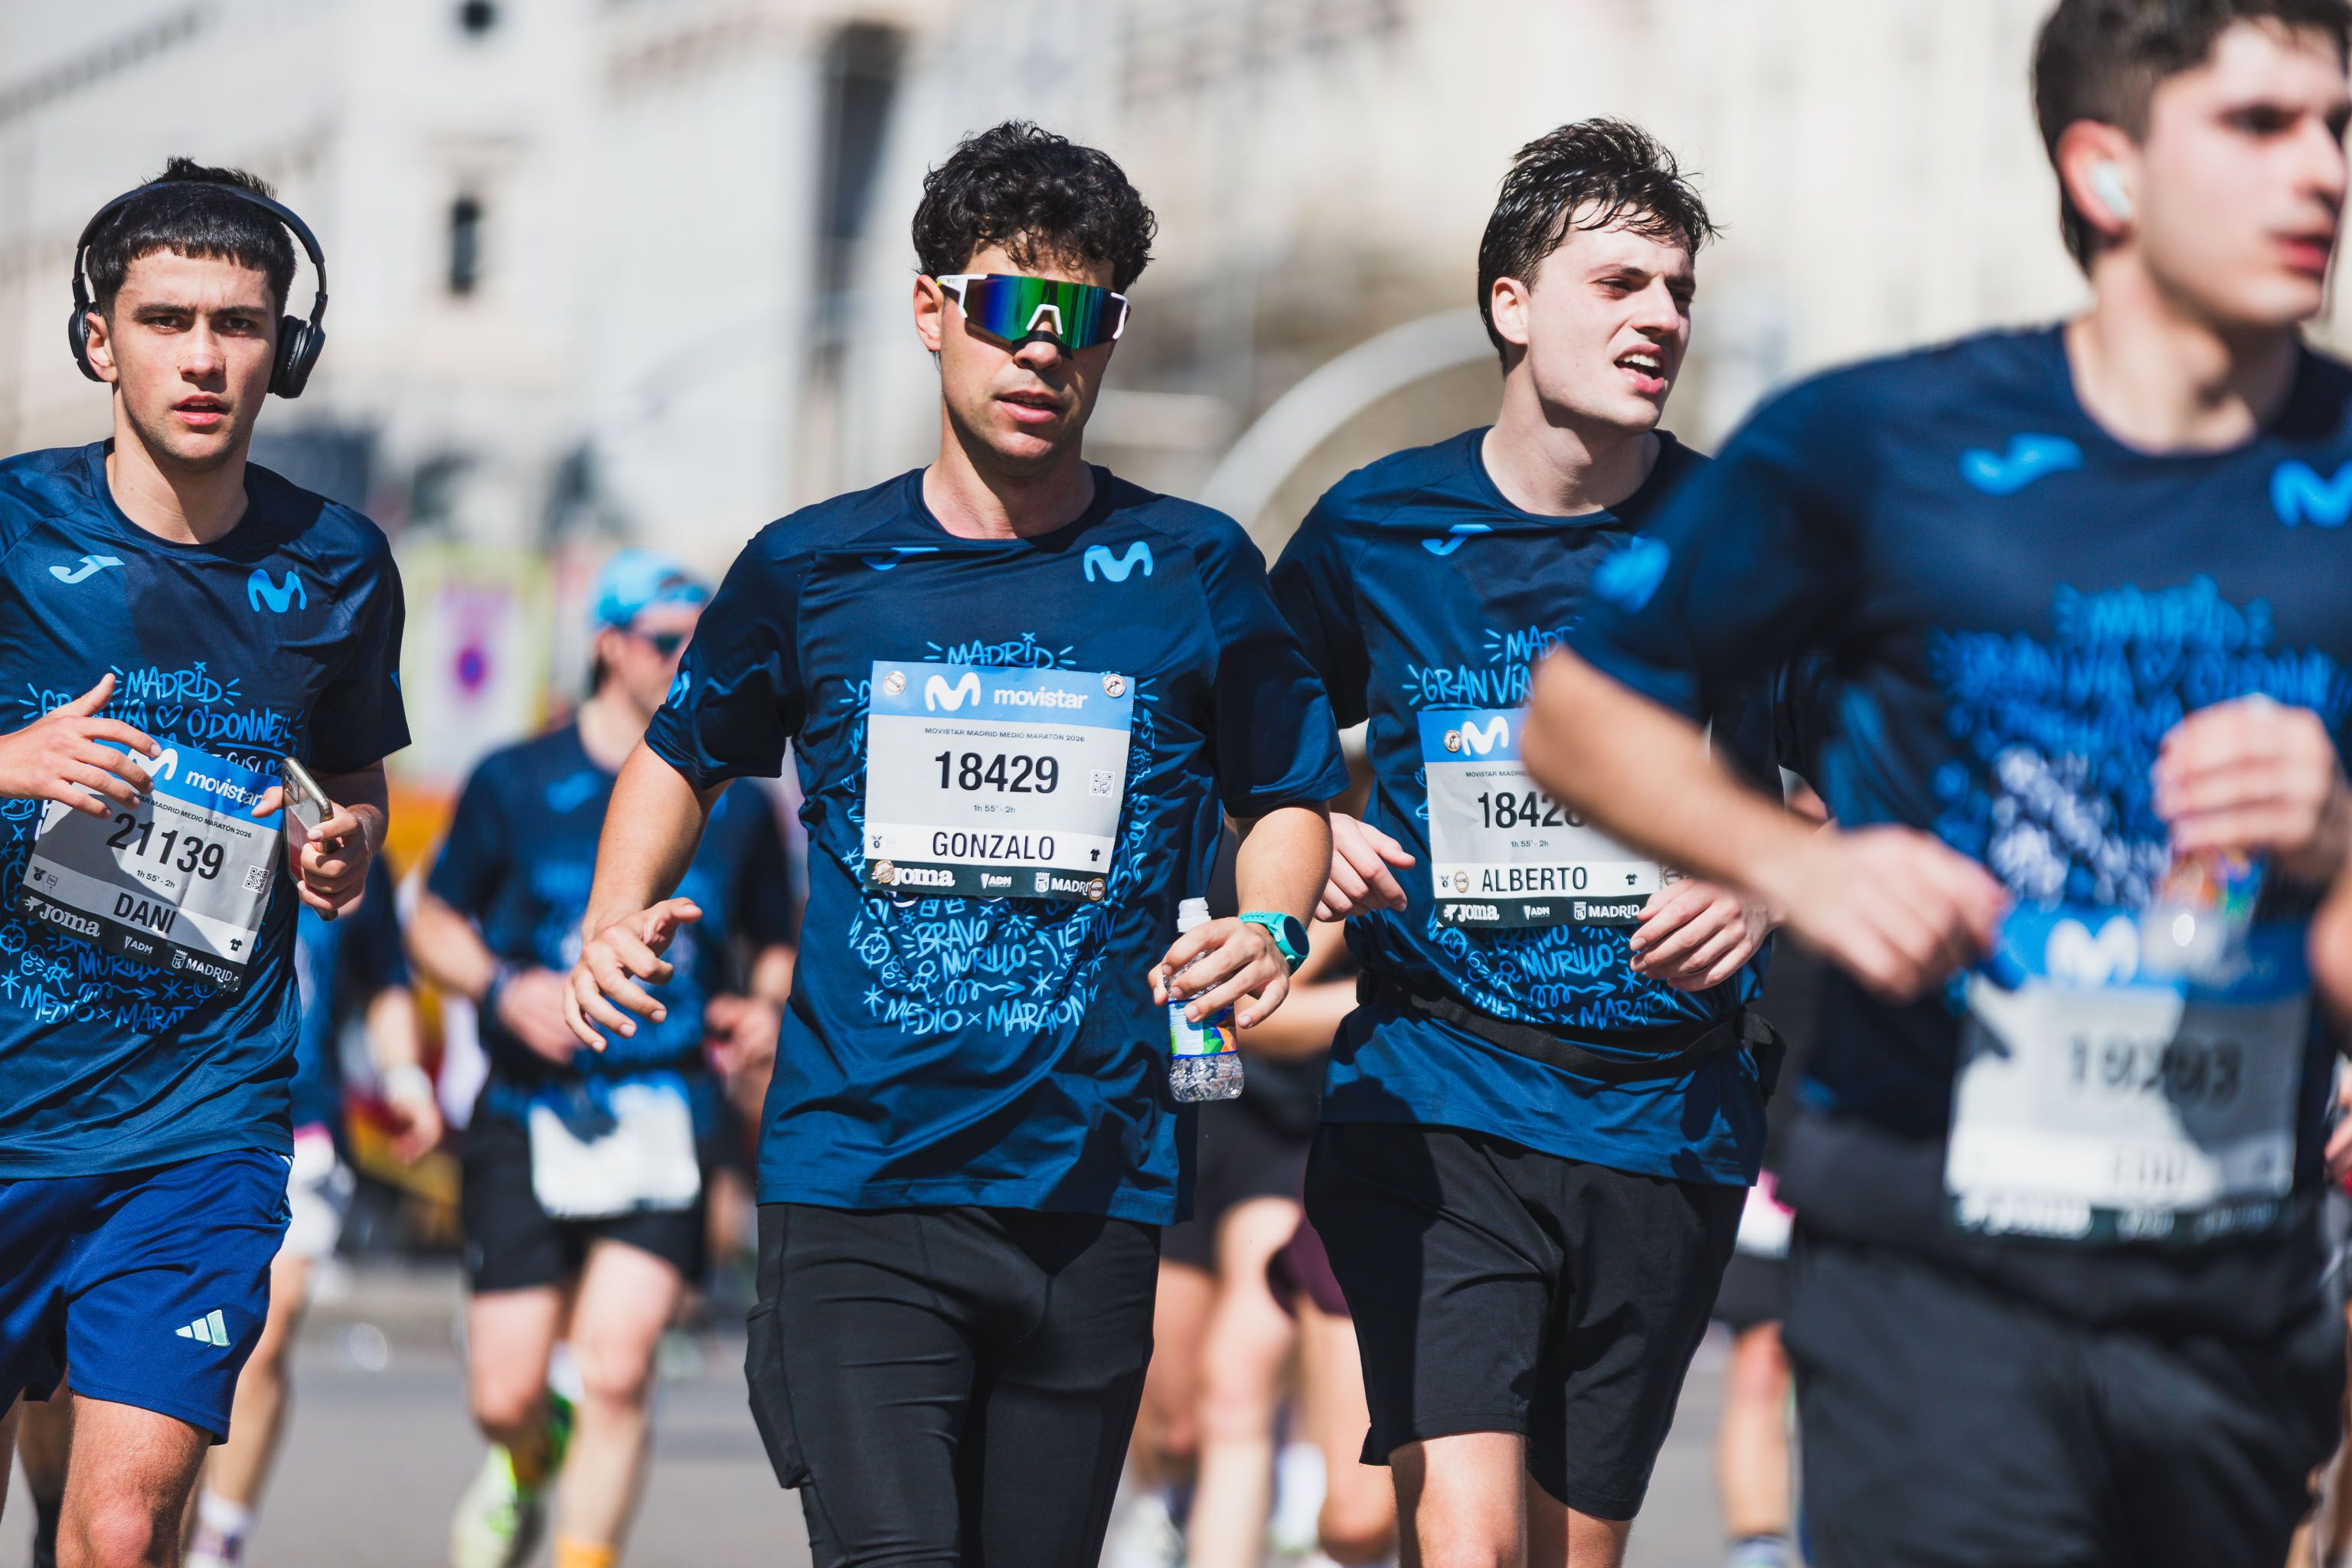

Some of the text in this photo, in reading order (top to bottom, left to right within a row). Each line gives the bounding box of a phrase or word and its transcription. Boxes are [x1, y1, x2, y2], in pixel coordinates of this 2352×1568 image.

[947, 632, 1054, 670] MADRID
[126, 662, 222, 704] MADRID
[993, 686, 1089, 710] movistar
[1422, 664, 1488, 704] GRAN
[925, 727, 965, 736] MOVISTAR
[966, 729, 998, 737] MADRID
[185, 770, 264, 807] movistar
[935, 750, 1060, 794] 18429
[152, 800, 179, 815] MADRID
[180, 809, 203, 823] MEDIO
[235, 828, 252, 838] 2026
[106, 812, 225, 880] 21139
[932, 831, 1055, 861] GONZALO
[136, 870, 145, 878] 1h
[165, 880, 175, 888] 2h
[1051, 877, 1090, 897] MADRI
[1481, 867, 1589, 893] ALBERTO
[113, 892, 180, 934] DANI
[1588, 904, 1640, 919] MADRID
[913, 916, 988, 959] BRAVO
[185, 958, 233, 983] MADRID
[942, 942, 1027, 982] MURILLO
[1520, 942, 1614, 982] MURILLO
[884, 995, 963, 1035] MEDIO
